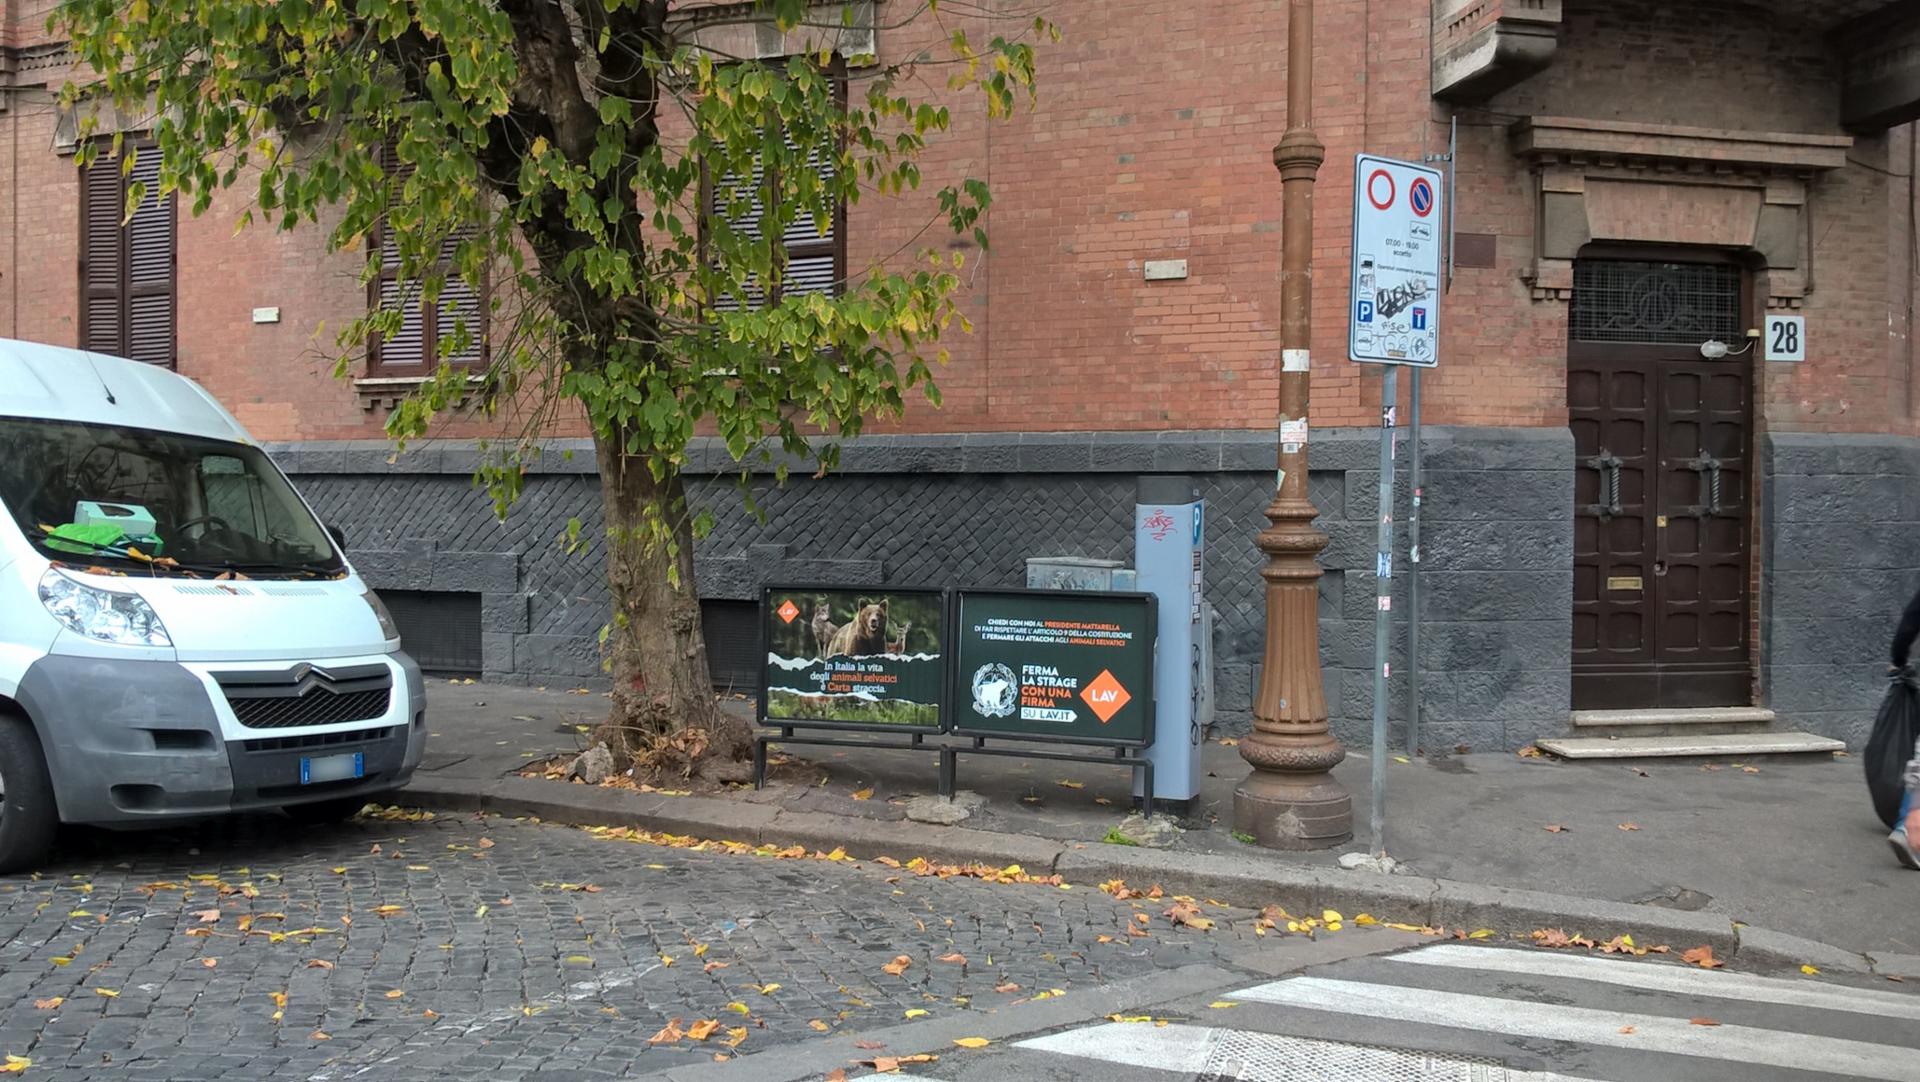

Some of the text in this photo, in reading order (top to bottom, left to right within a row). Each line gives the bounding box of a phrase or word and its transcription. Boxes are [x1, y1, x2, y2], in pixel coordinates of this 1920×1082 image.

[1360, 303, 1371, 321] P
[1772, 321, 1798, 354] 28
[987, 618, 1008, 626] CHIEDI
[1009, 619, 1022, 627] CON
[1036, 620, 1044, 628] AL
[1044, 621, 1081, 630] PRESIDENTE
[1081, 622, 1120, 631] MATTARELLA
[994, 626, 1027, 635] RISPETTARE
[1088, 630, 1133, 639] COSTITUZIONE
[1025, 635, 1054, 643] ATTACCHI
[1055, 636, 1069, 644] AGLI
[1070, 637, 1095, 645] ANIMALI
[1096, 639, 1126, 647] SELVATICI
[824, 661, 884, 673] In Italia la vita
[1022, 664, 1059, 677] FERMA
[810, 671, 898, 684] degli animali selvatici
[1021, 675, 1078, 688] LA STRAGE
[827, 682, 851, 692] Carta
[1021, 686, 1072, 698] CON UNA
[1021, 696, 1056, 708] FIRMA
[1091, 688, 1118, 703] LAV
[1023, 708, 1071, 721] SU LAV.IT
